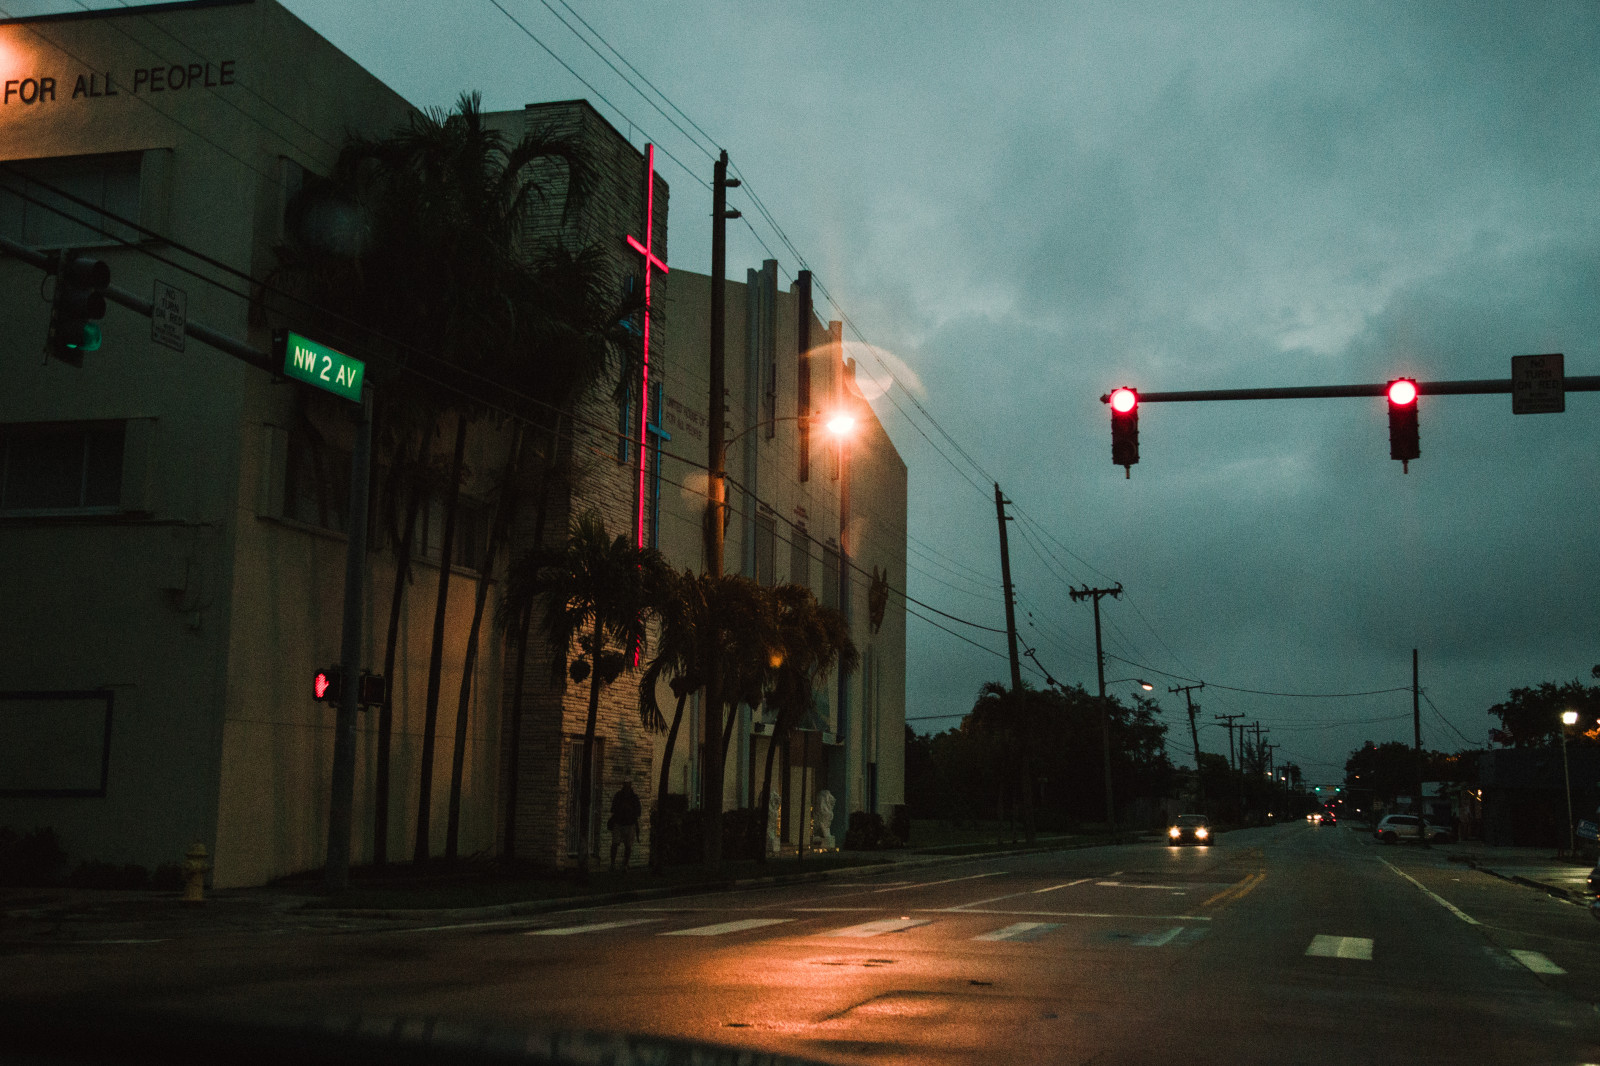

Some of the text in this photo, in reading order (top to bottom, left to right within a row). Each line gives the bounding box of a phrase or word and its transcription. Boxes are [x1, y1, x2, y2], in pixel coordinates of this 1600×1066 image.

[4, 60, 235, 105] FOR ALL PEOPLE
[294, 345, 356, 388] NW 2 AV
